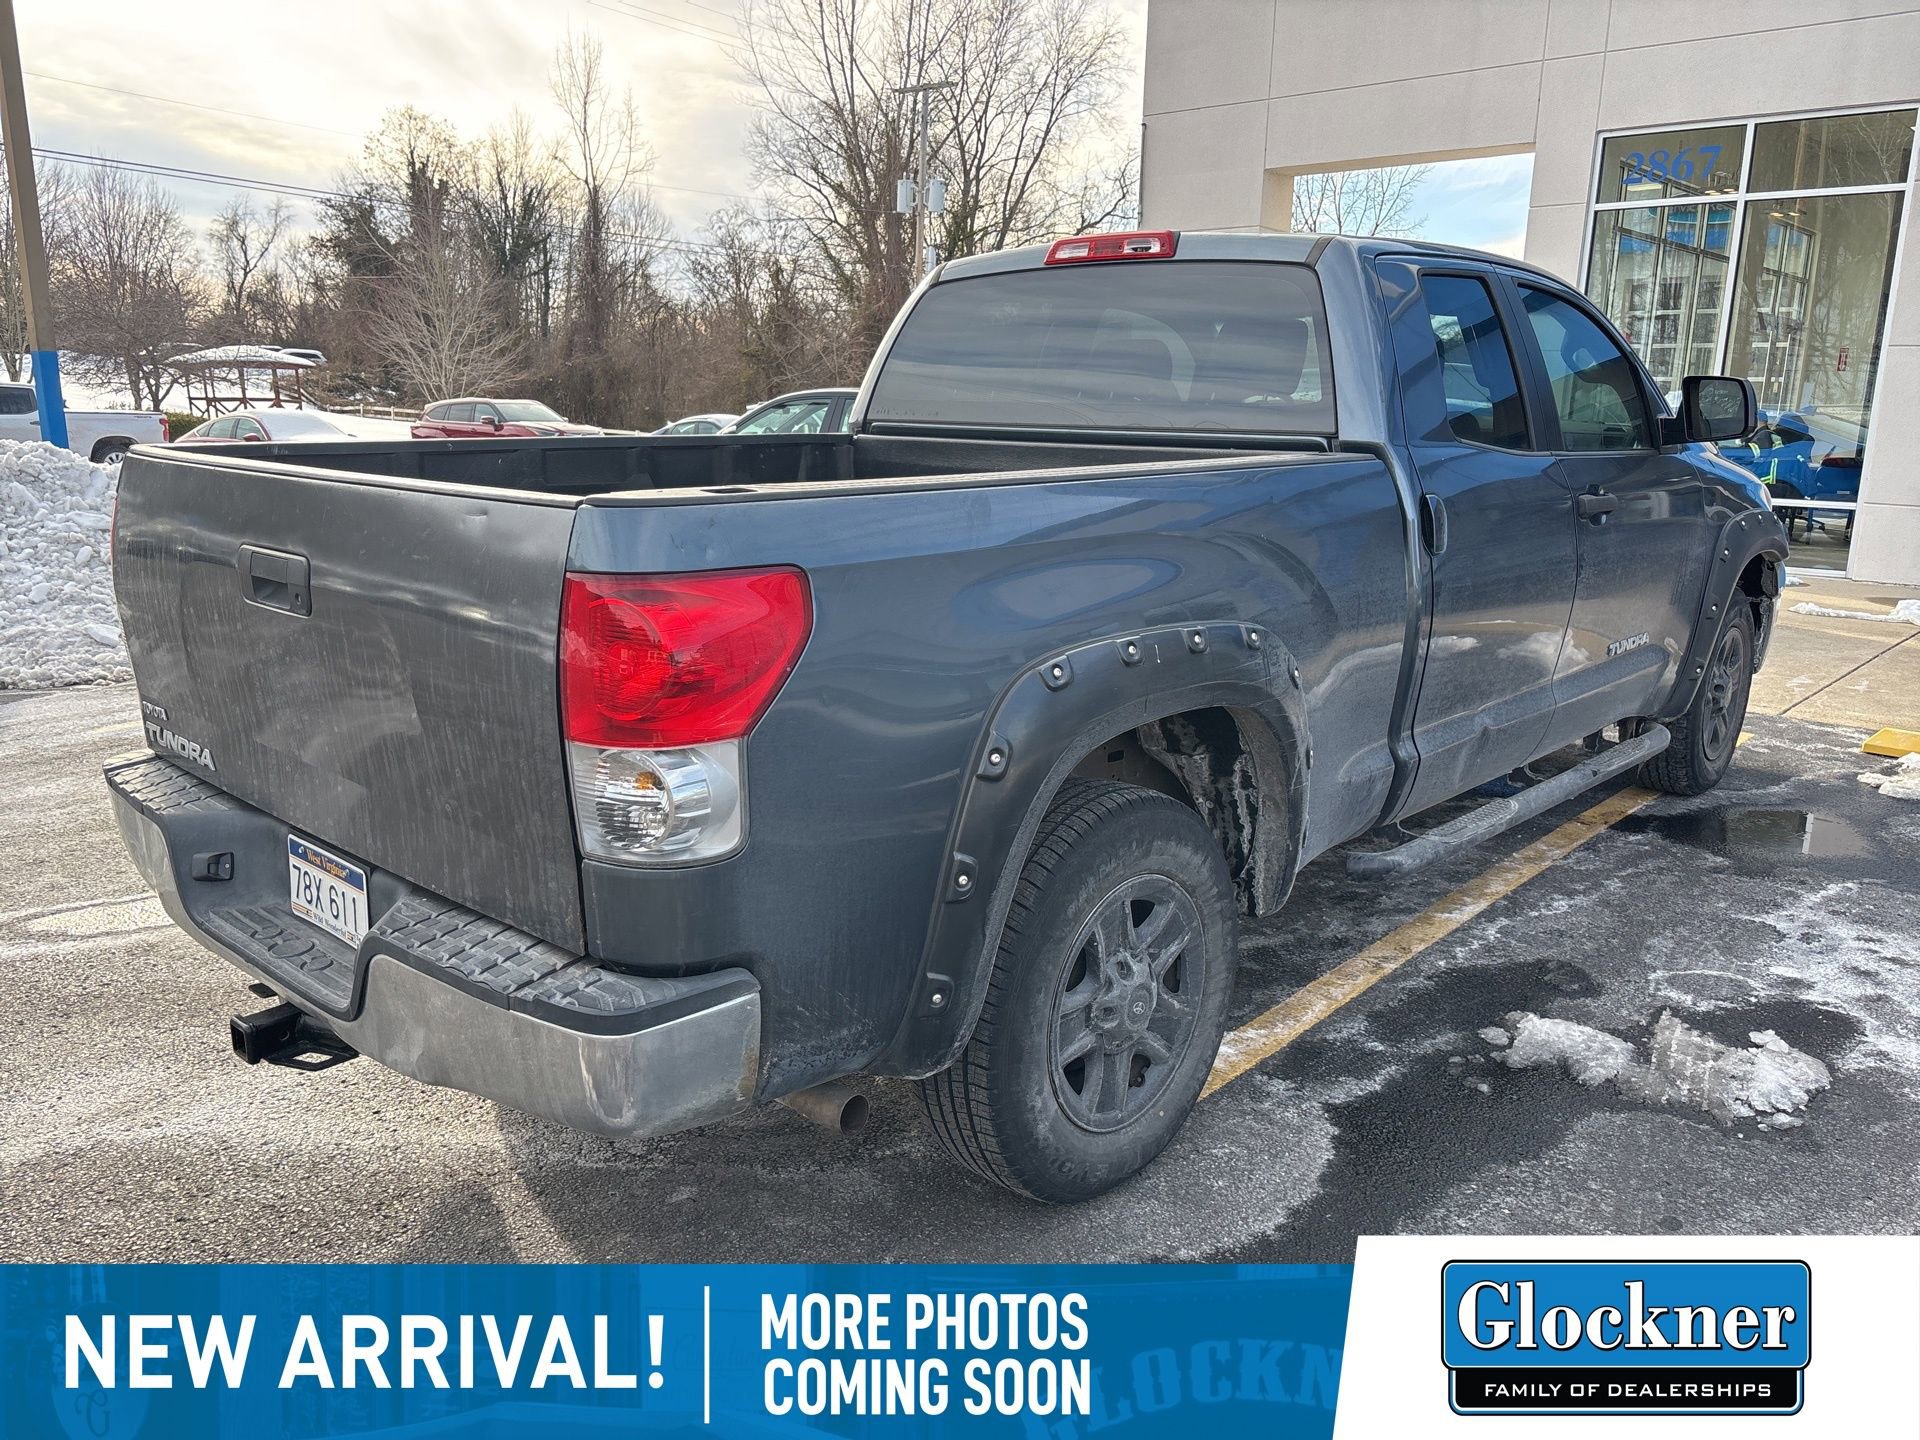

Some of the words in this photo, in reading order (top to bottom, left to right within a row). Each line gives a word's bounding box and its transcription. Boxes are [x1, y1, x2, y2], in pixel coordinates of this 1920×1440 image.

[1622, 144, 1723, 185] 2867
[1608, 632, 1650, 657] TUNDRA
[142, 701, 168, 721] TOYOTA
[145, 720, 216, 771] TUNDRA
[307, 849, 321, 865] West
[292, 863, 324, 913] 78X
[329, 884, 358, 934] 611
